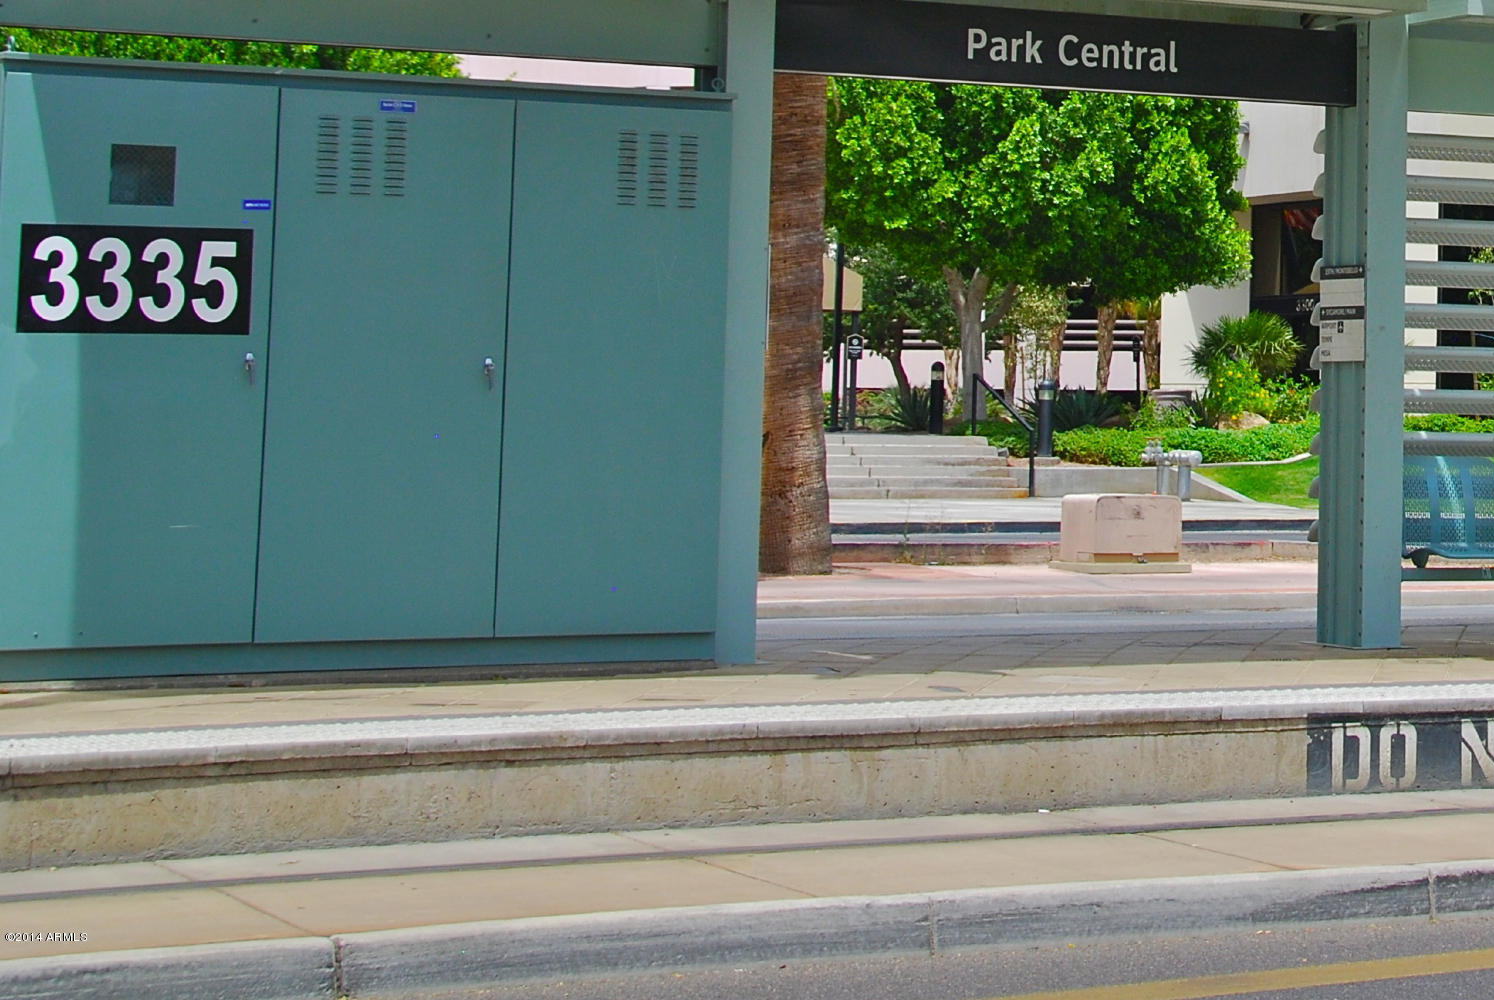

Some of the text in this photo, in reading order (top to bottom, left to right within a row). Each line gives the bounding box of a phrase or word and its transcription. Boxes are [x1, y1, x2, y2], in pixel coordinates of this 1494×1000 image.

[967, 27, 1178, 73] Park Central
[30, 235, 239, 323] 3335
[1330, 720, 1418, 793] DO
